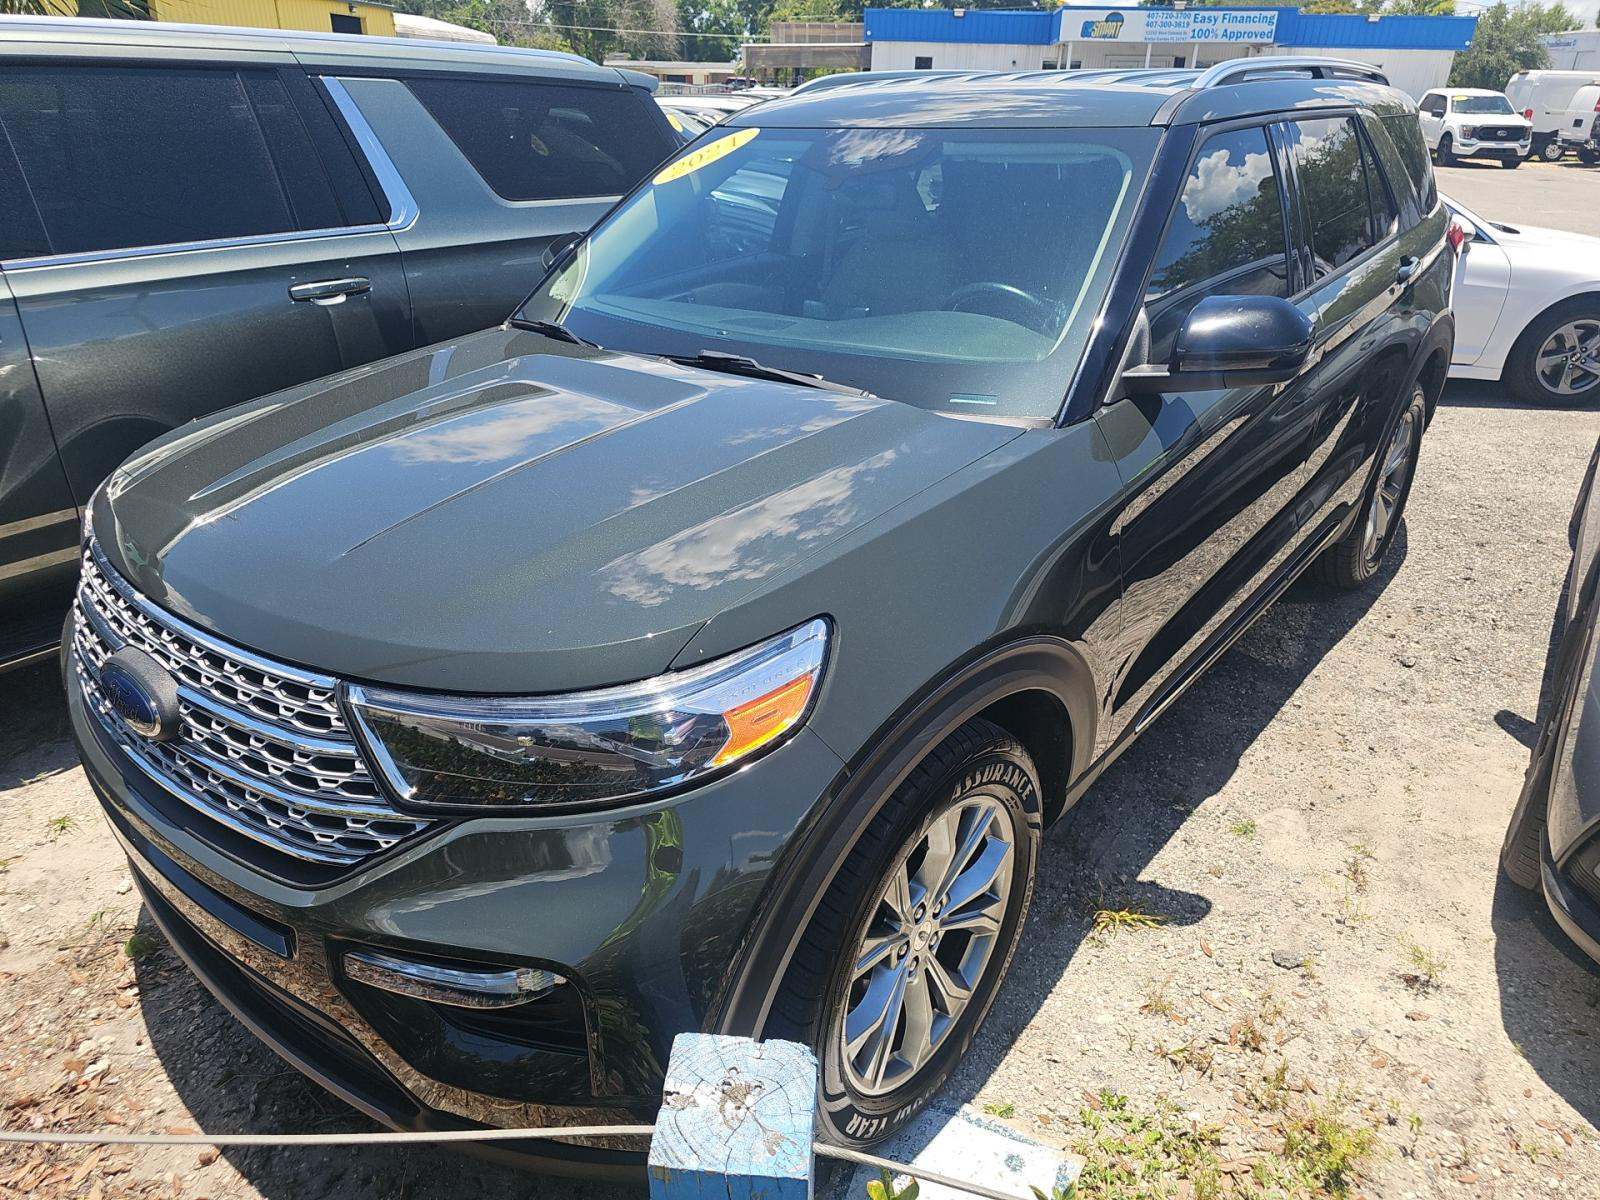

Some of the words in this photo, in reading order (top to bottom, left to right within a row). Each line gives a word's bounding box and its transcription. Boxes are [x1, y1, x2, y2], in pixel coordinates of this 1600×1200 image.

[1193, 13, 1218, 26] Easy
[1221, 13, 1275, 26] Financing
[1191, 28, 1219, 39] 100%
[1221, 28, 1273, 40] Approved
[951, 763, 1033, 802] ASSURANCE
